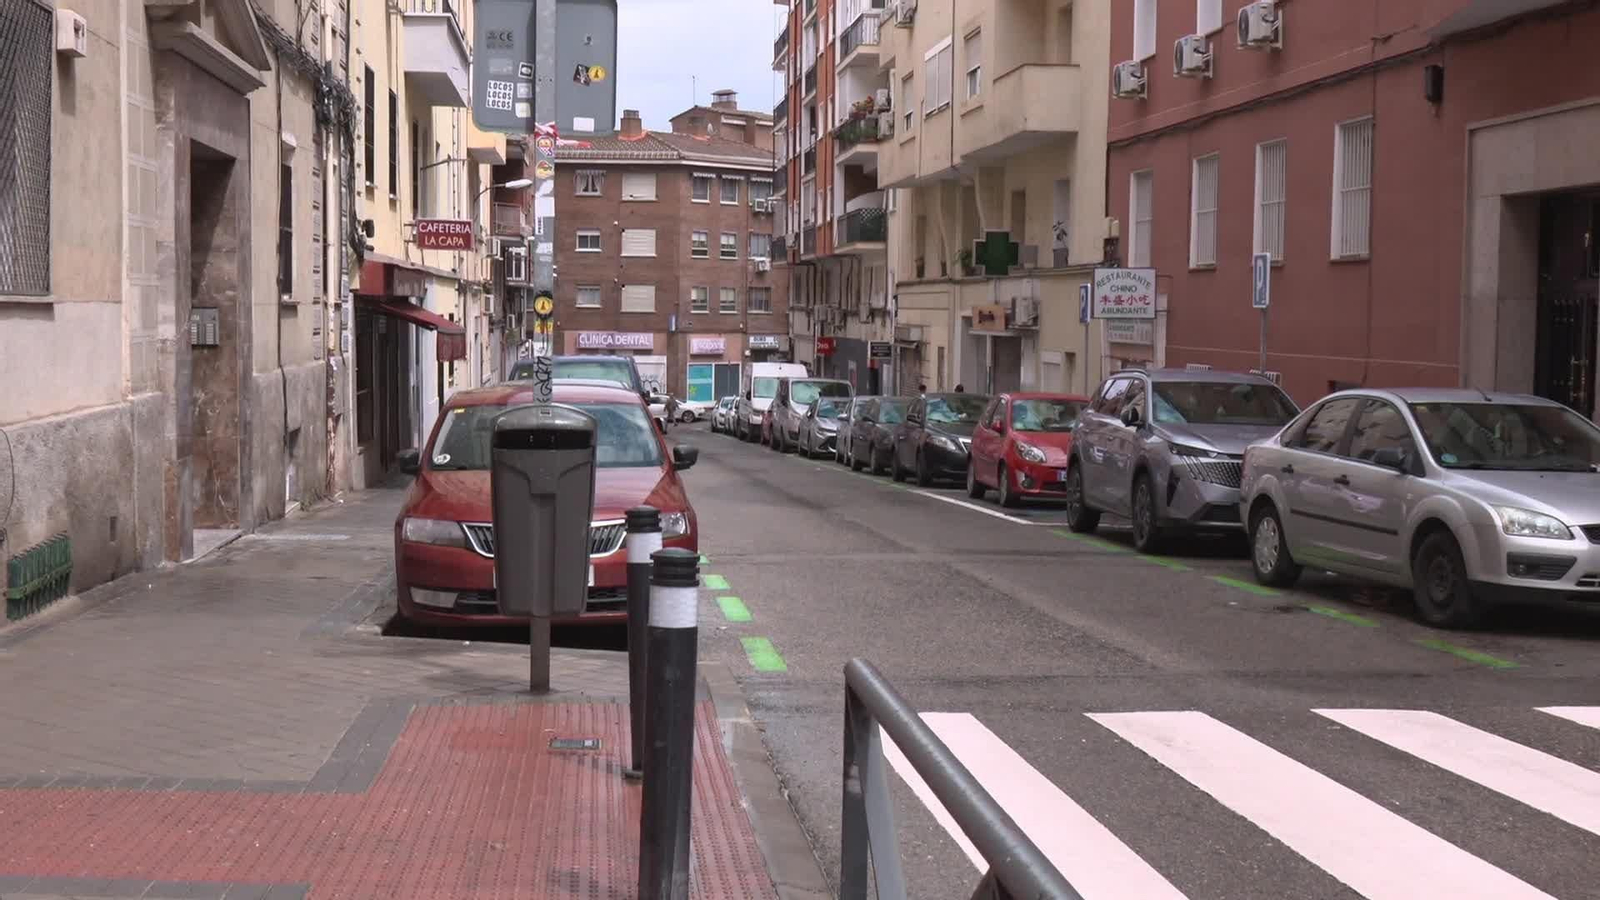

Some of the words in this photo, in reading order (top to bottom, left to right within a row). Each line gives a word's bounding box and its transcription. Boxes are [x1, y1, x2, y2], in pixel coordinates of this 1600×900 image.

[488, 82, 513, 91] LOCOS
[487, 91, 512, 100] LOCOS
[486, 99, 511, 108] LOCOS
[419, 222, 471, 234] CAFETERIA
[424, 235, 437, 246] LA
[438, 235, 465, 247] CAPA
[1096, 271, 1152, 290] RESTAURANTE
[1110, 284, 1138, 293] CHINO
[1101, 306, 1148, 315] ABUNDANTE
[615, 334, 650, 345] DENTAL
